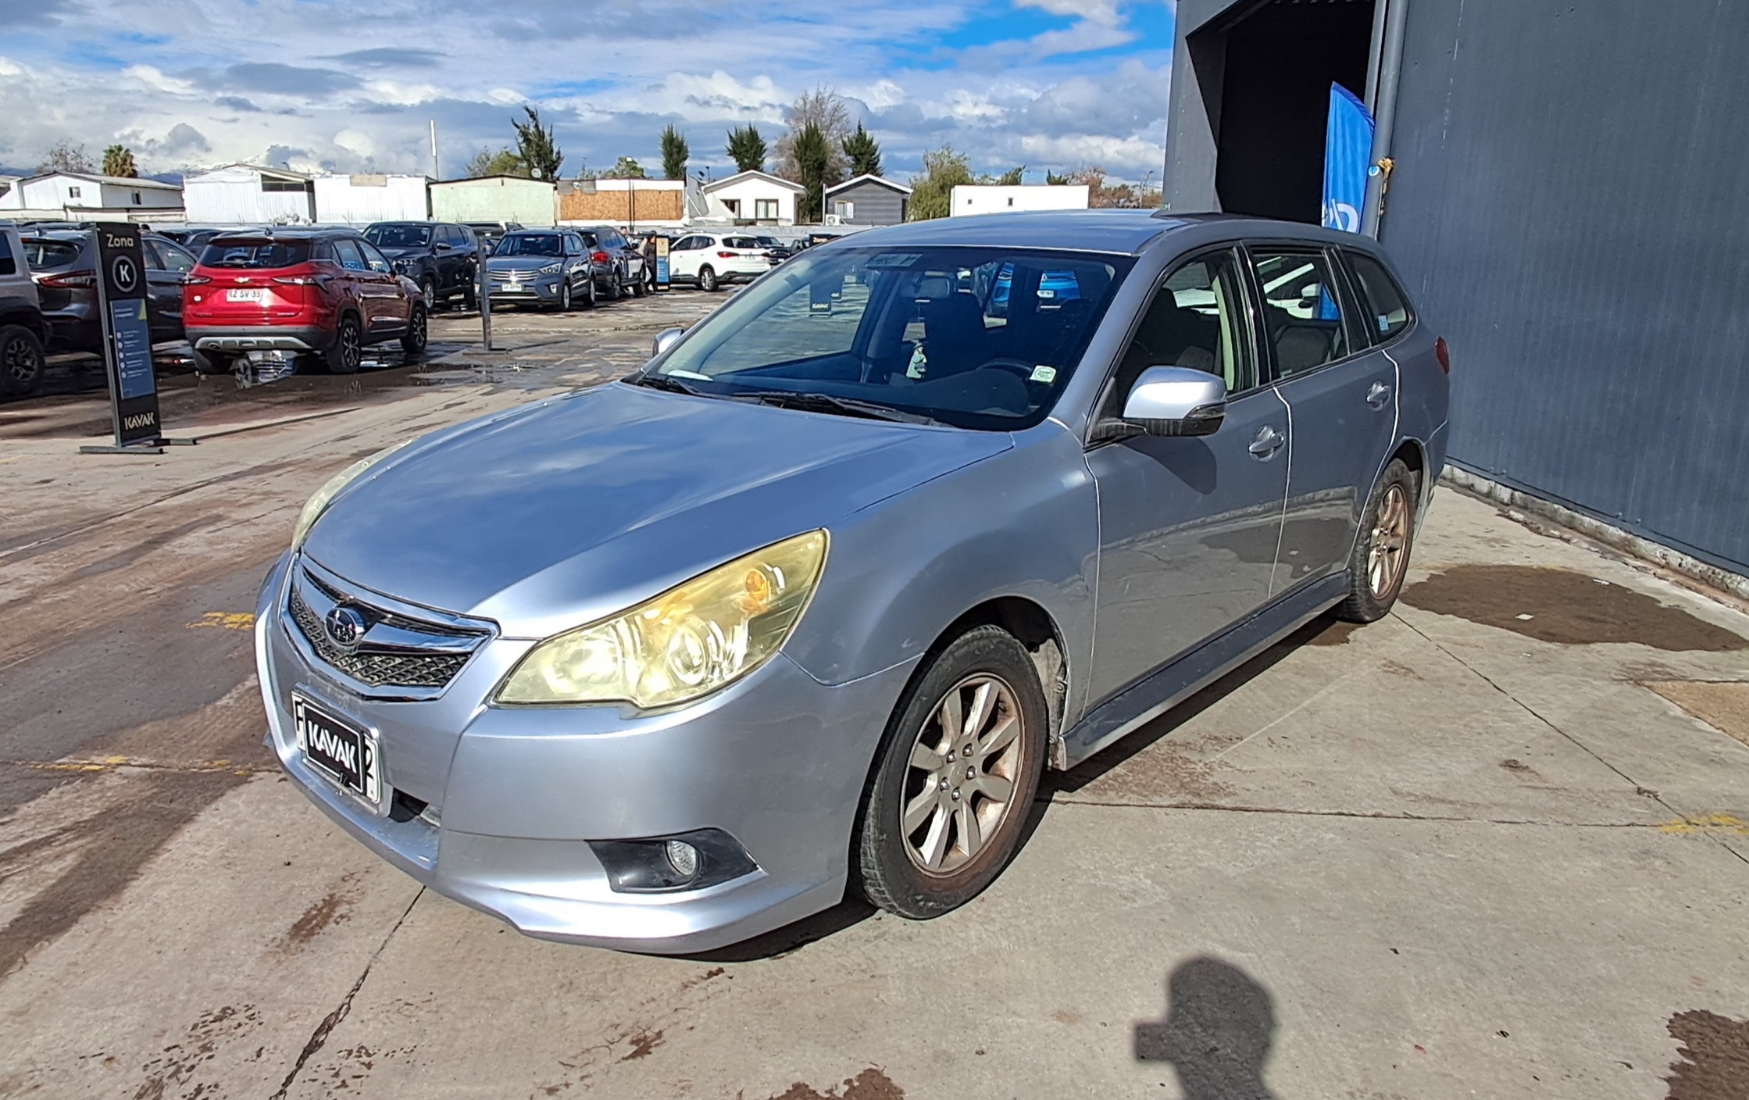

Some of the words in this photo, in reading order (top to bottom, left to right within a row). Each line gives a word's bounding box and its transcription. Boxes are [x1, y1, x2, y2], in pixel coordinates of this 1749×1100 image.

[106, 233, 134, 248] Zona
[119, 264, 131, 283] K
[124, 412, 156, 431] KAVAK
[307, 720, 358, 774] KAVAK
